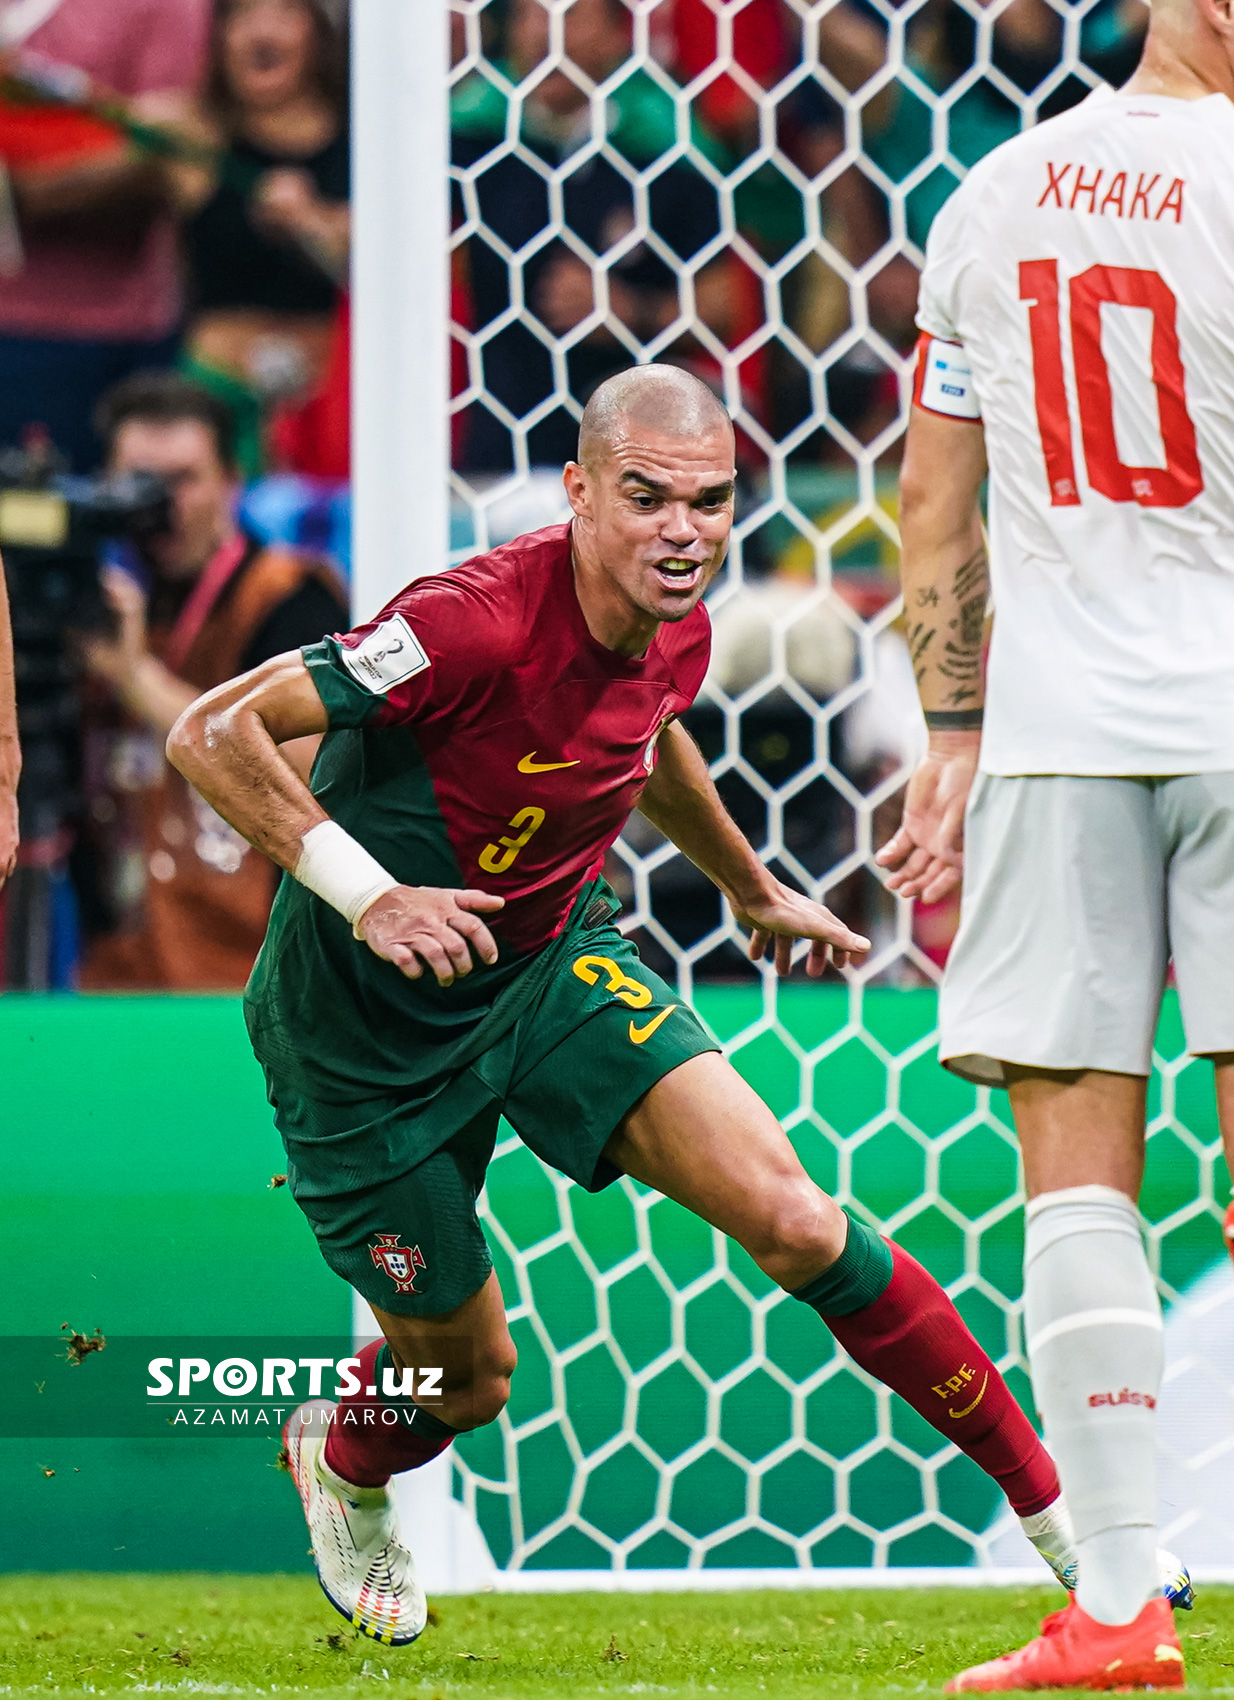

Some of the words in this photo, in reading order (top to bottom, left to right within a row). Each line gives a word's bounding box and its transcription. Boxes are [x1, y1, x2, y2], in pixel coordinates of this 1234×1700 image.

[1037, 162, 1185, 223] XHAKA
[1018, 258, 1205, 508] 10
[478, 806, 546, 874] 3
[572, 955, 653, 1009] 3
